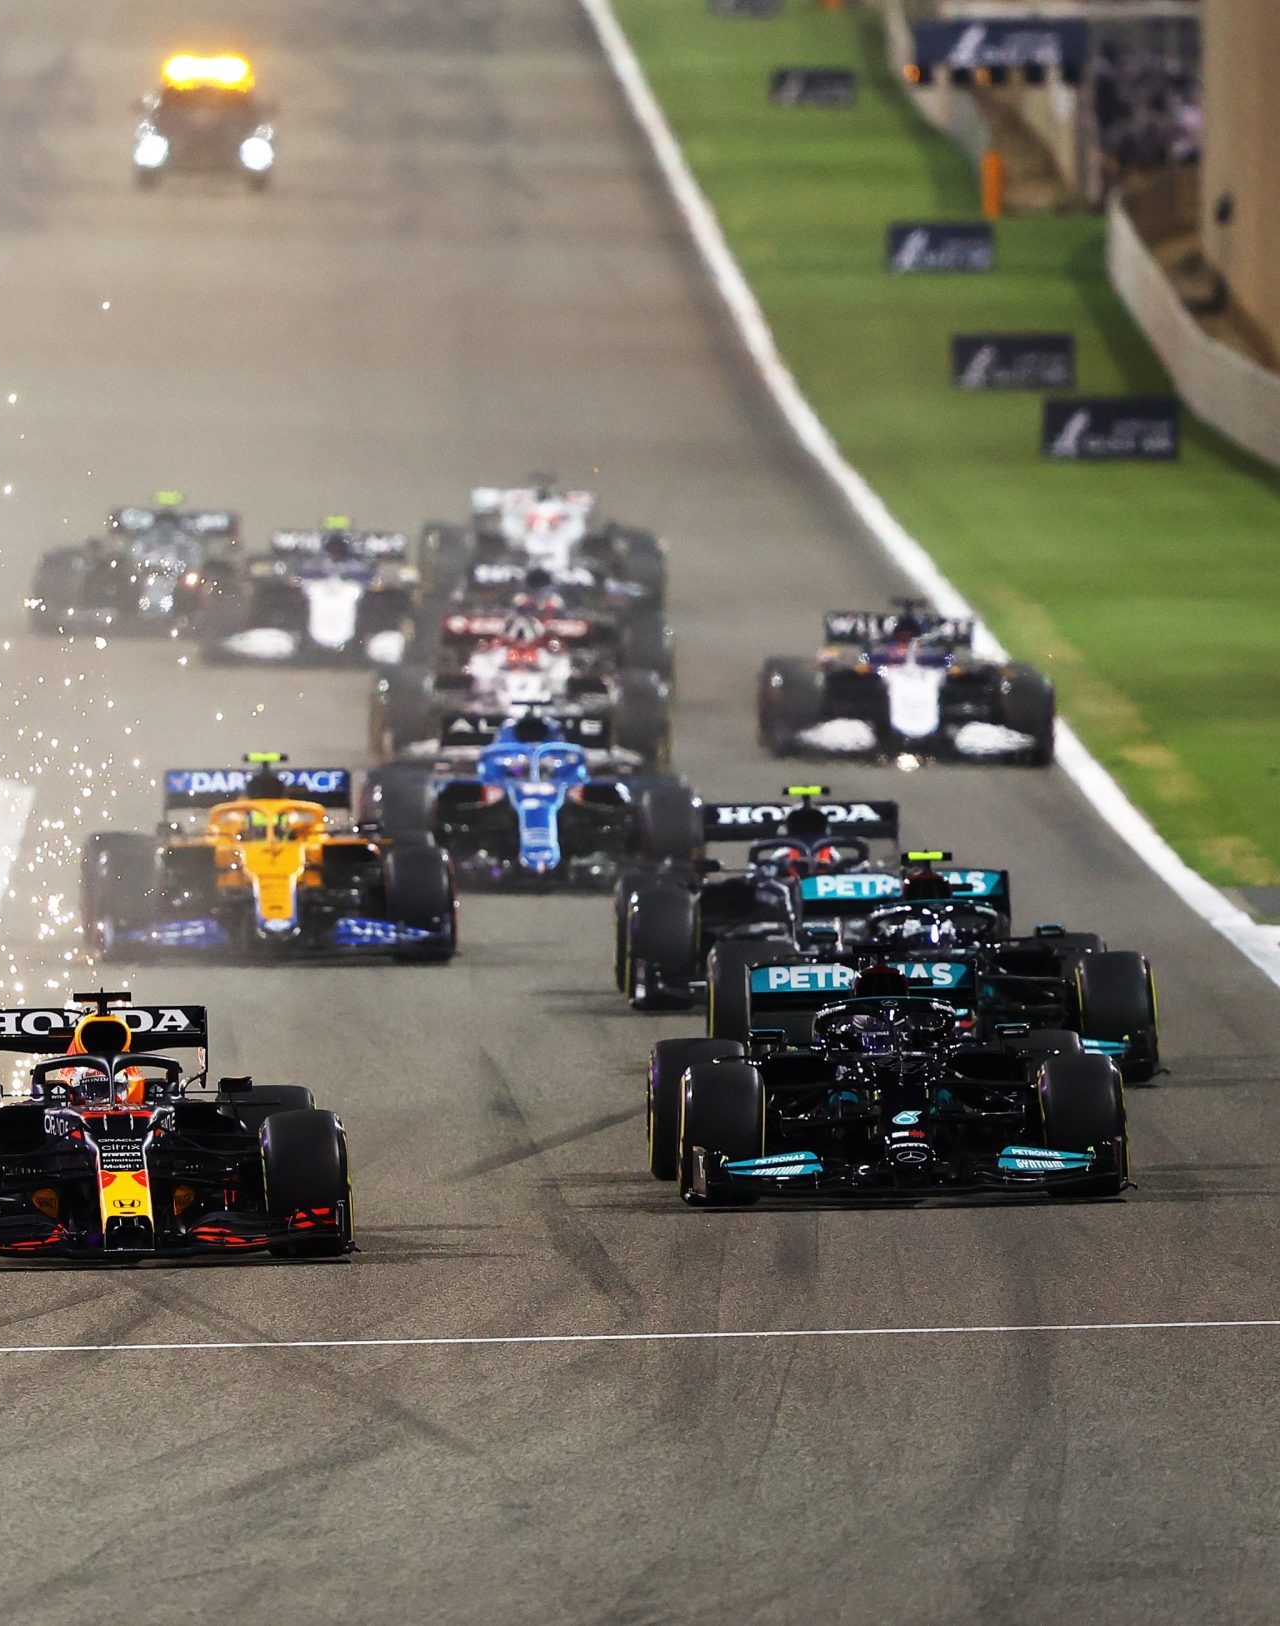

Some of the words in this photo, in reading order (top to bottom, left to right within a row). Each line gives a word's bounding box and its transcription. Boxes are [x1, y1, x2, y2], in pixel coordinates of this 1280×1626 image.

[718, 804, 880, 824] HODA
[770, 963, 953, 989] PETRAS
[755, 1153, 806, 1165] PETRONAS
[1010, 1148, 1061, 1158] PETRONAS
